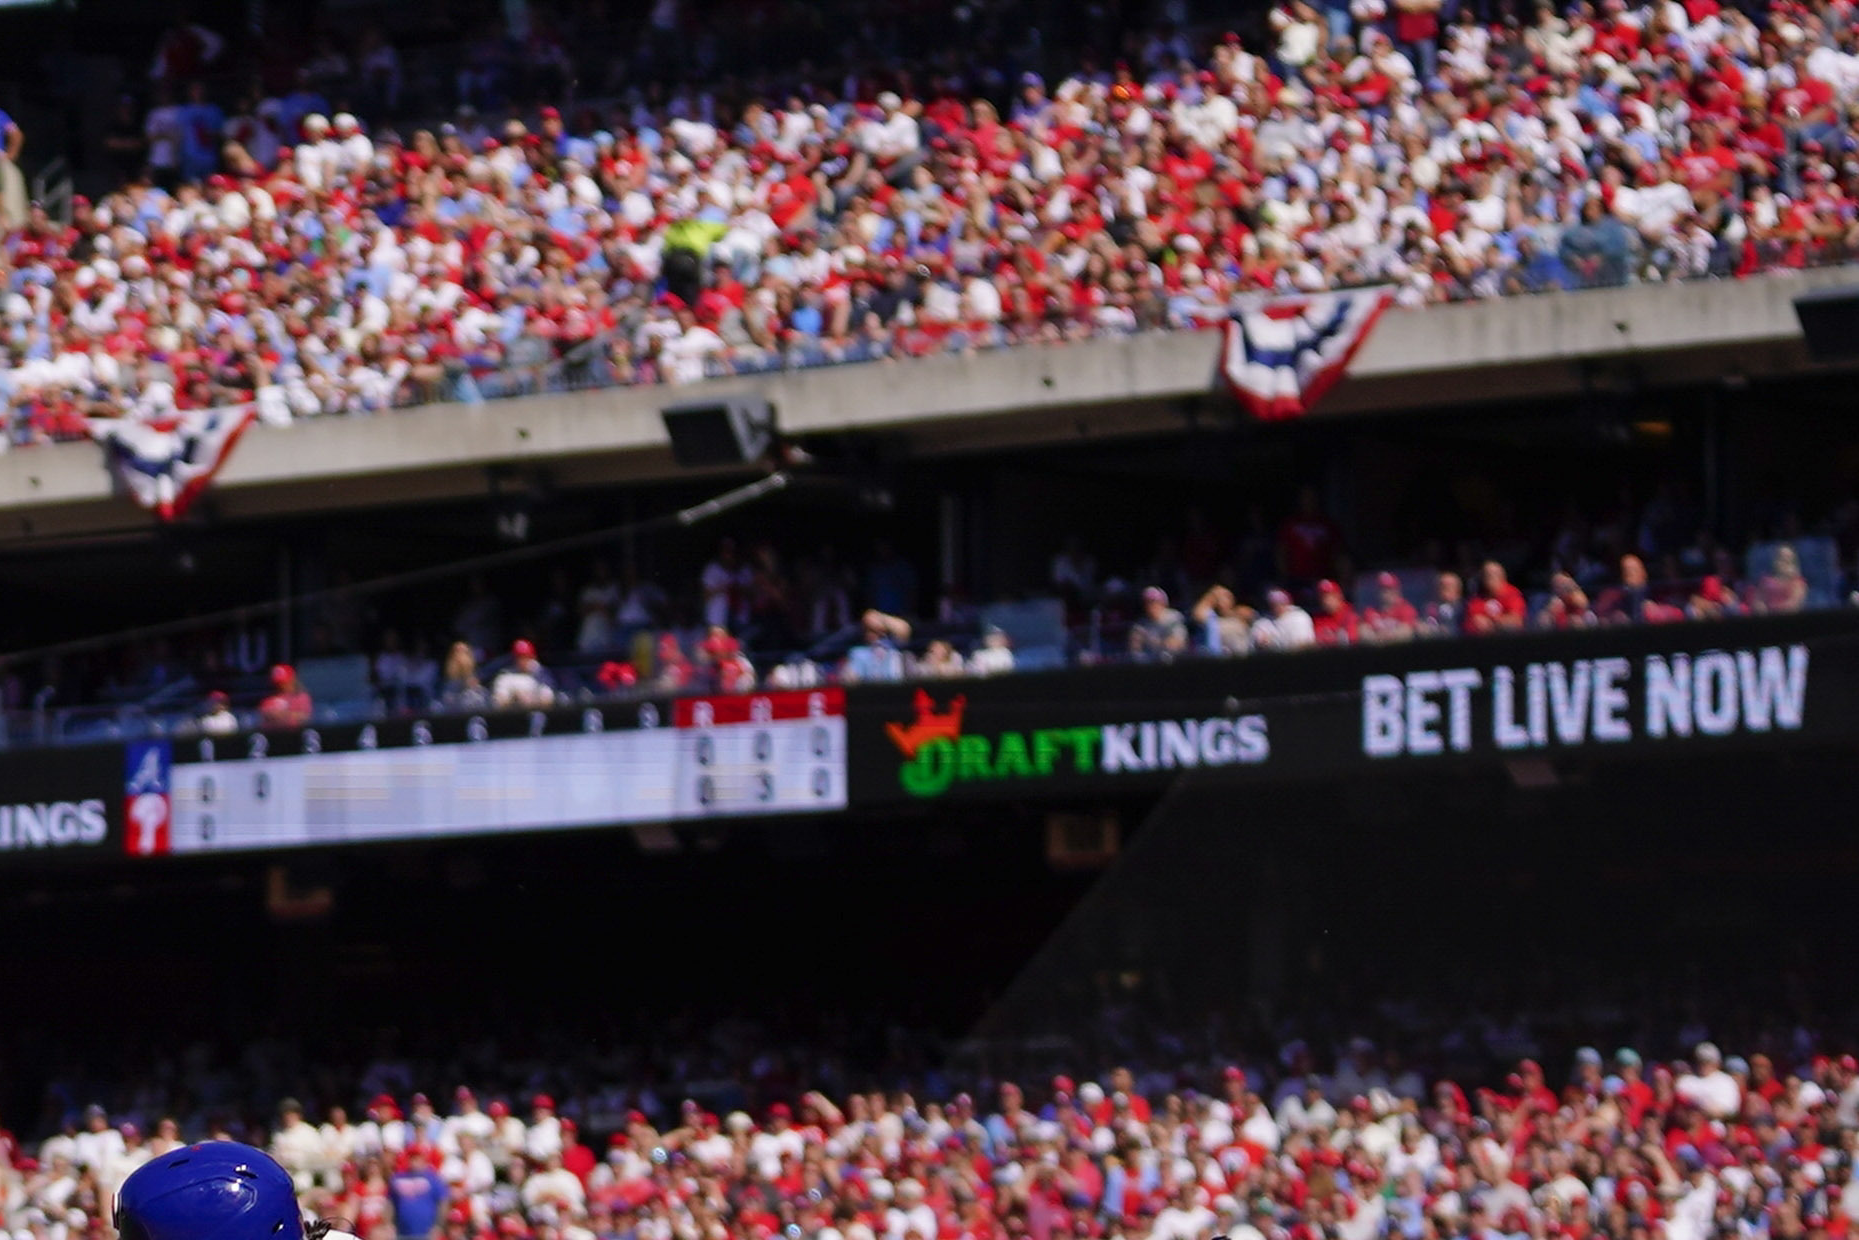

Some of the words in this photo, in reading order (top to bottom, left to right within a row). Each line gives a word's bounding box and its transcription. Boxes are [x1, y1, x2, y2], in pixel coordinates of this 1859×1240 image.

[1361, 668, 1482, 757] BET
[1492, 657, 1632, 749] LIVE
[1645, 646, 1810, 738] NOW
[900, 715, 1270, 796] DRAFTKINGS
